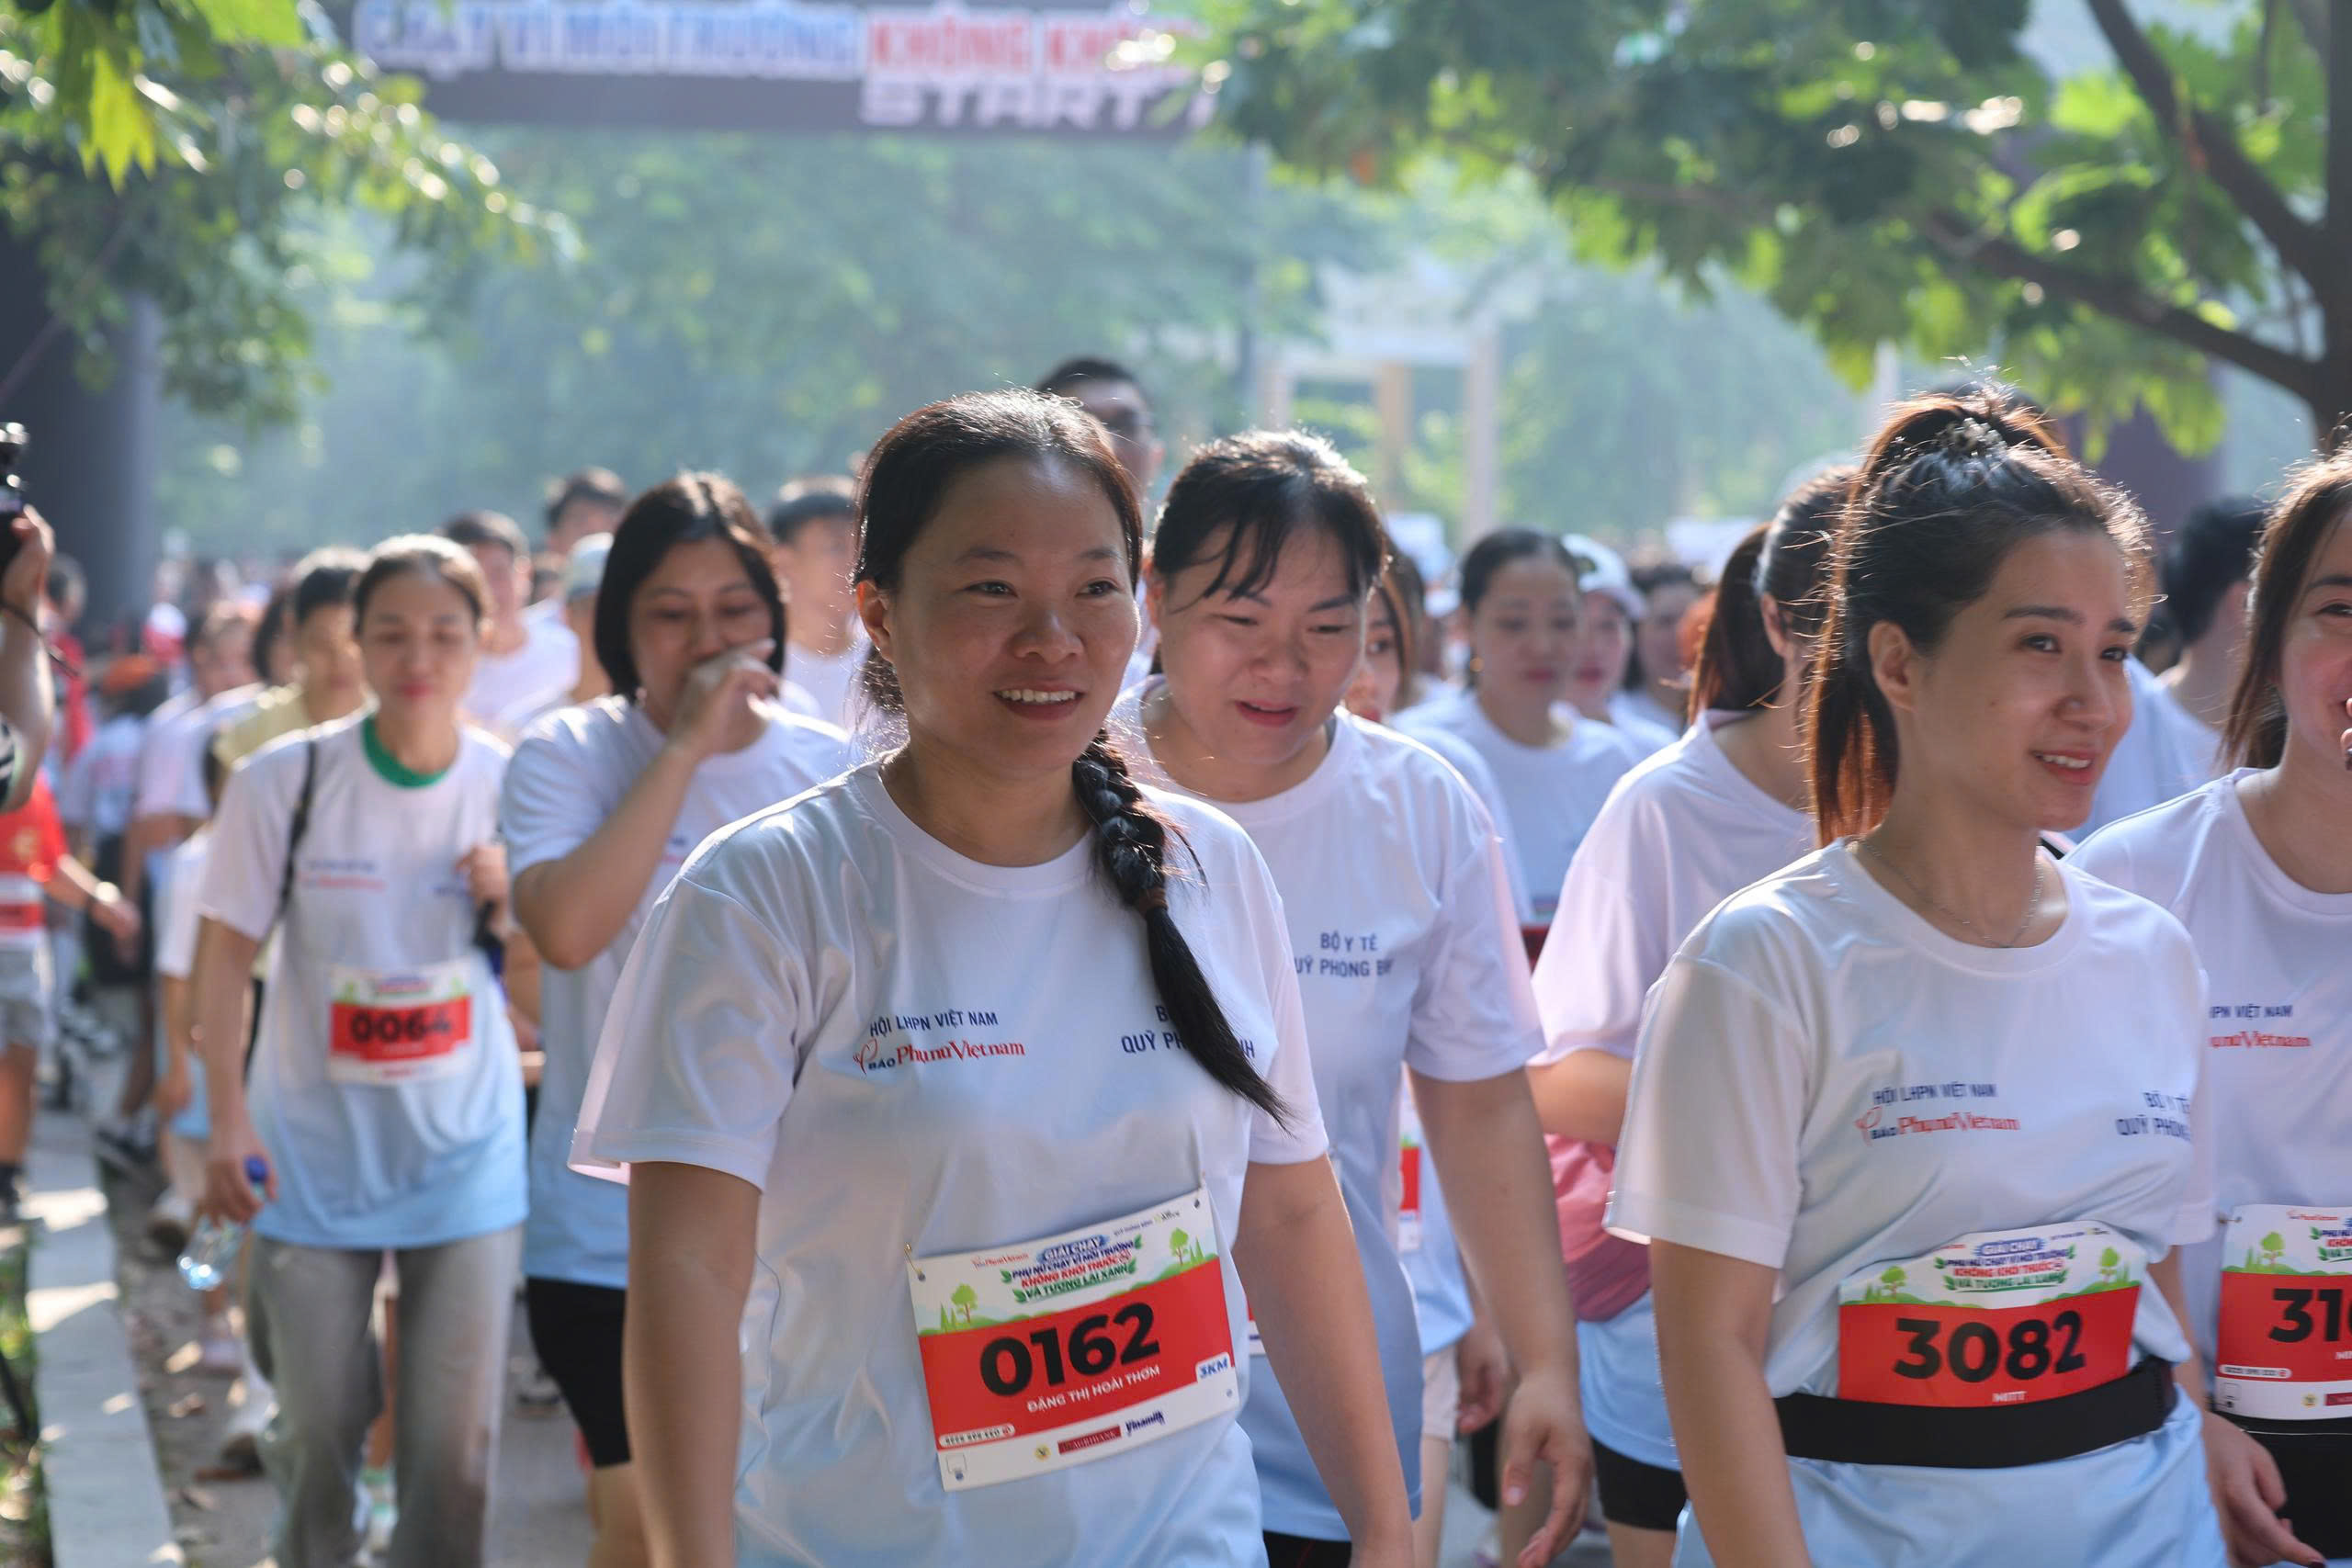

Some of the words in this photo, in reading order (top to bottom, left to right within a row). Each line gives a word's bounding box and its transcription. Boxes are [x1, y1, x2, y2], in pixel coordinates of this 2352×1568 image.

[1344, 936, 1354, 953] Y
[350, 1010, 452, 1044] 0064
[870, 1016, 892, 1038] HỘI
[897, 1014, 931, 1032] LHPN
[934, 1009, 965, 1030] VIỆT
[968, 1010, 999, 1027] NAM
[1969, 1083, 1997, 1098] NAM
[2268, 1288, 2352, 1343] 31
[979, 1302, 1160, 1397] 0162
[1892, 1310, 2086, 1383] 3082
[1199, 1357, 1229, 1378] 3KM
[1027, 1392, 1066, 1413] ĐẶNG
[1069, 1387, 1091, 1404] THỊ
[1092, 1377, 1125, 1397] HOÀI
[1125, 1364, 1161, 1386] THƠM
